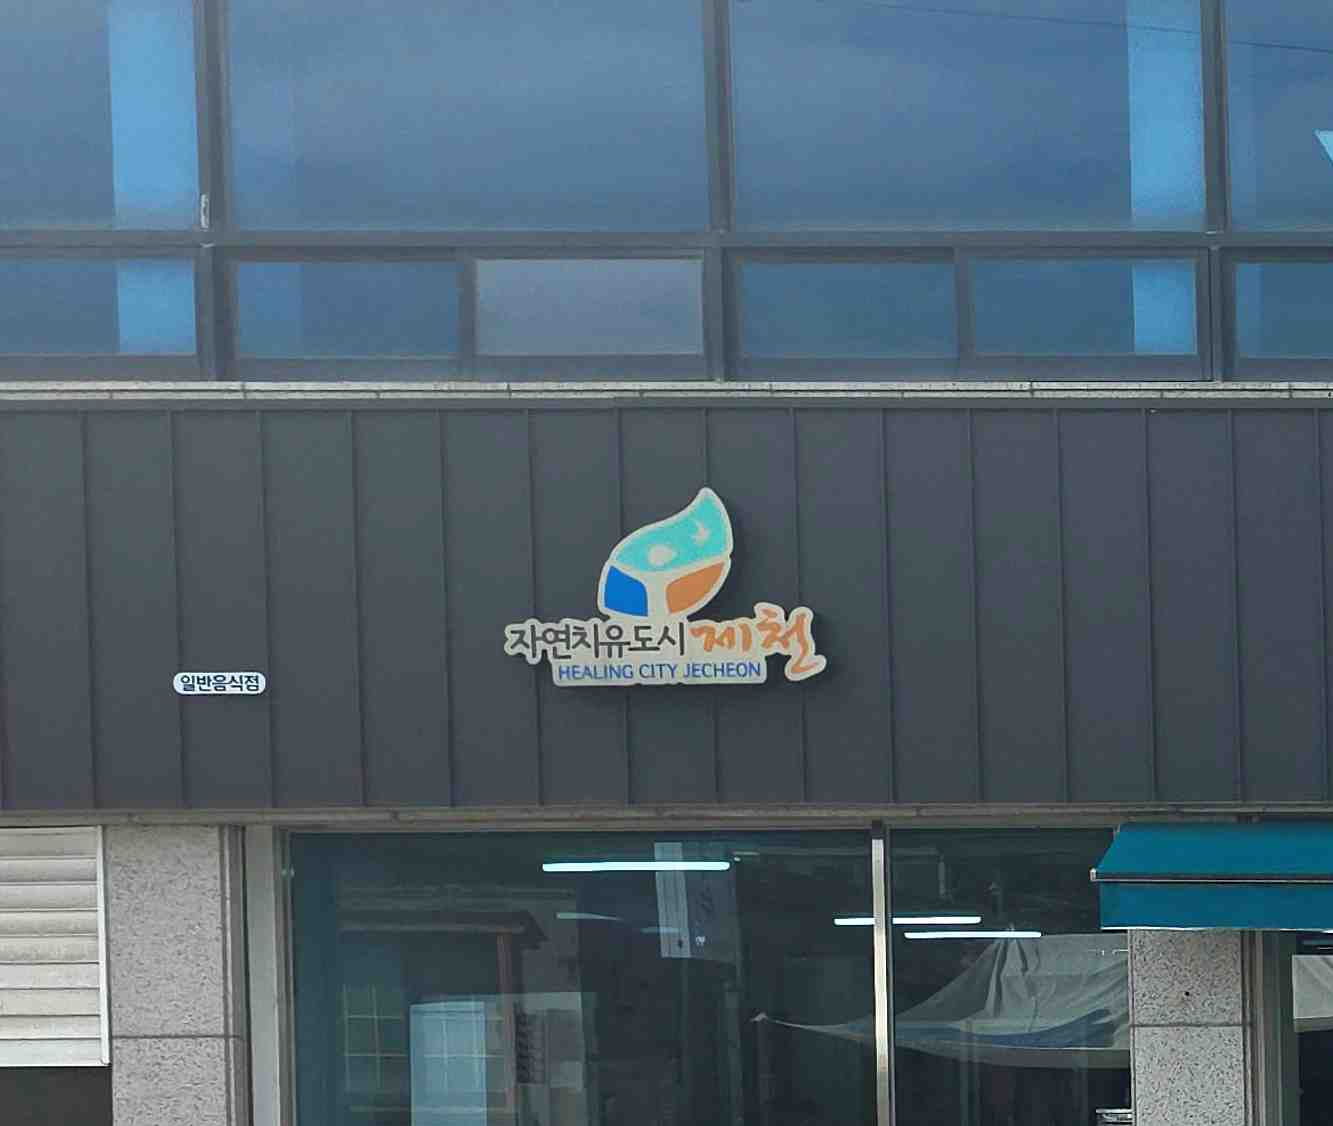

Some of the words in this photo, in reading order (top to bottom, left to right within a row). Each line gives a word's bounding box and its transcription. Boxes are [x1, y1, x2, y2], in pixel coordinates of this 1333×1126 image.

[510, 621, 685, 659] 자연치유도시
[689, 607, 817, 673] 제천
[558, 663, 633, 680] HEALING
[639, 663, 678, 679] CITY
[683, 661, 761, 678] JECHEON
[181, 675, 259, 692] 일반음식점
